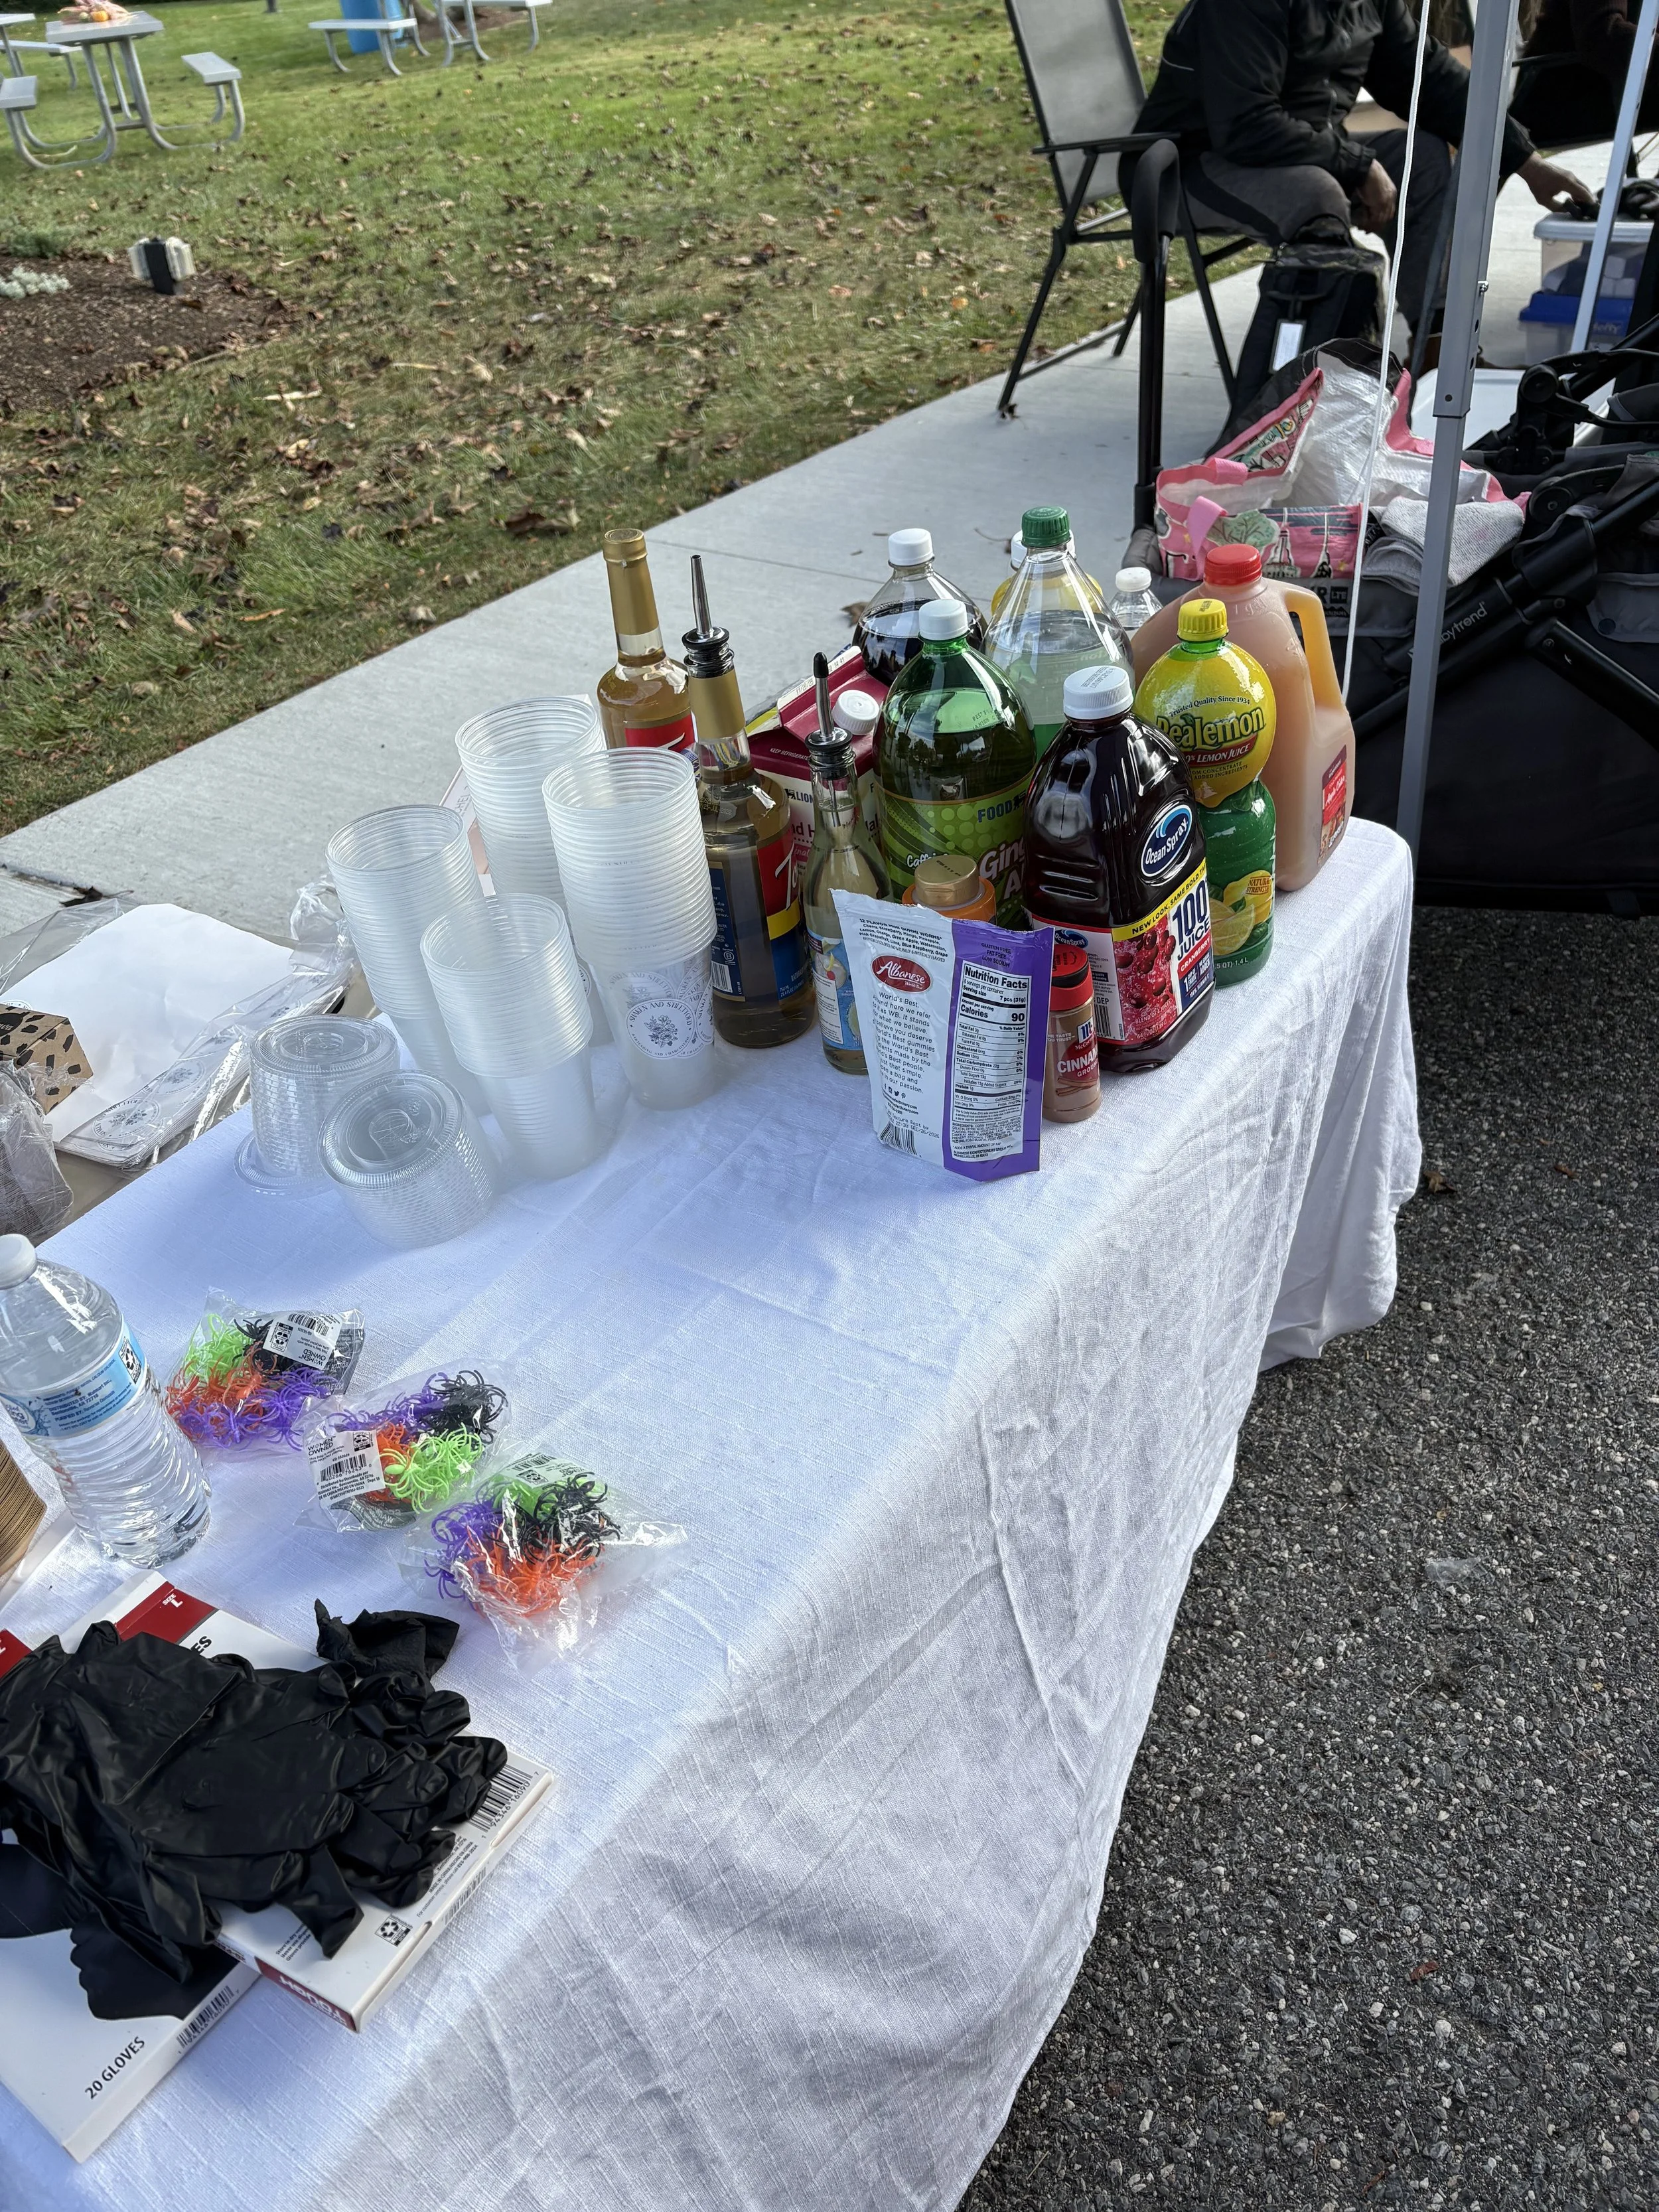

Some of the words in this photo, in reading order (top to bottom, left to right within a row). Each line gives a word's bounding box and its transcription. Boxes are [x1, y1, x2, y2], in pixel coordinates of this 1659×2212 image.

[1440, 601, 1487, 644] bytrend
[1169, 701, 1192, 717] Trusted
[1193, 697, 1216, 707] Quality
[1237, 696, 1250, 705] 1934
[782, 750, 809, 761] REFRIGERATE
[1185, 754, 1195, 763] 0%
[1197, 751, 1227, 763] LEMON
[1228, 743, 1250, 759] JUICE
[1202, 761, 1242, 774] CONCENTRATE
[1215, 765, 1248, 777] INGREDIENTS
[977, 800, 1012, 823] FOOD
[1145, 848, 1166, 865] Ocean
[1167, 818, 1189, 853] Spray
[1131, 920, 1151, 935] NEW
[1152, 906, 1170, 924] LOOK,
[1170, 890, 1185, 906] SAME
[1185, 875, 1199, 891] BOLD
[879, 926, 902, 935] Strawberry,
[920, 940, 947, 952] Watermelon,
[981, 942, 1000, 951] GLUTEN
[1054, 932, 1070, 946] Ocean
[1070, 938, 1085, 947] Spray
[1177, 918, 1210, 961] JUICE
[912, 945, 934, 954] Raspberry,
[1181, 938, 1210, 972] CRANBERRY
[993, 958, 1010, 968] SODIUM
[1235, 958, 1244, 966] 1.4
[876, 960, 926, 984] Albanese
[964, 966, 999, 985] Nutrition
[1001, 977, 1027, 989] Facts
[963, 986, 977, 995] Serving
[879, 991, 902, 1003] World's
[904, 998, 920, 1008] Best.
[1097, 996, 1110, 1005] DEP
[629, 1005, 648, 1022] SHAKEN
[888, 1010, 901, 1019] WB.
[909, 1017, 930, 1027] stands
[890, 1003, 904, 1011] here
[916, 1011, 931, 1019] refer
[960, 1004, 988, 1018] Calories
[1011, 1013, 1025, 1022] 90
[879, 1013, 892, 1023] what
[903, 1023, 928, 1035] believe.
[1135, 1015, 1151, 1024] BLEND
[893, 1033, 905, 1043] Best
[907, 1040, 936, 1053] gummies
[895, 1027, 906, 1036] you
[908, 1032, 932, 1043] deserve
[881, 1037, 890, 1045] the
[892, 1041, 913, 1053] World's
[914, 1049, 929, 1059] Best
[894, 1050, 910, 1059] made
[957, 1044, 977, 1053] Cholesterol
[889, 1054, 901, 1064] Best
[902, 1060, 925, 1072] people.
[1057, 1045, 1098, 1073] CINNAM
[889, 1063, 901, 1071] that
[902, 1068, 923, 1079] simple.
[1077, 1058, 1098, 1077] GROUN
[894, 1071, 905, 1080] bag
[906, 1076, 918, 1084] and
[899, 1081, 924, 1094] passion.
[303, 1349, 326, 1361] OWNED
[48, 1398, 79, 1412] DISTRIBUTED
[88, 1386, 105, 1399] Walmart
[54, 1414, 76, 1422] PURIFIED
[308, 1442, 334, 1456] OWNED
[318, 1487, 332, 1495] Walmart
[339, 1479, 359, 1488] Bentonville,
[321, 1479, 339, 1489] Distributed
[162, 1593, 177, 1605] SIZE
[171, 1599, 183, 1609] L
[490, 1805, 511, 1827] 94346
[511, 1781, 530, 1803] 16090
[84, 2080, 103, 2100] 20
[101, 2036, 145, 2081] GLOVES
